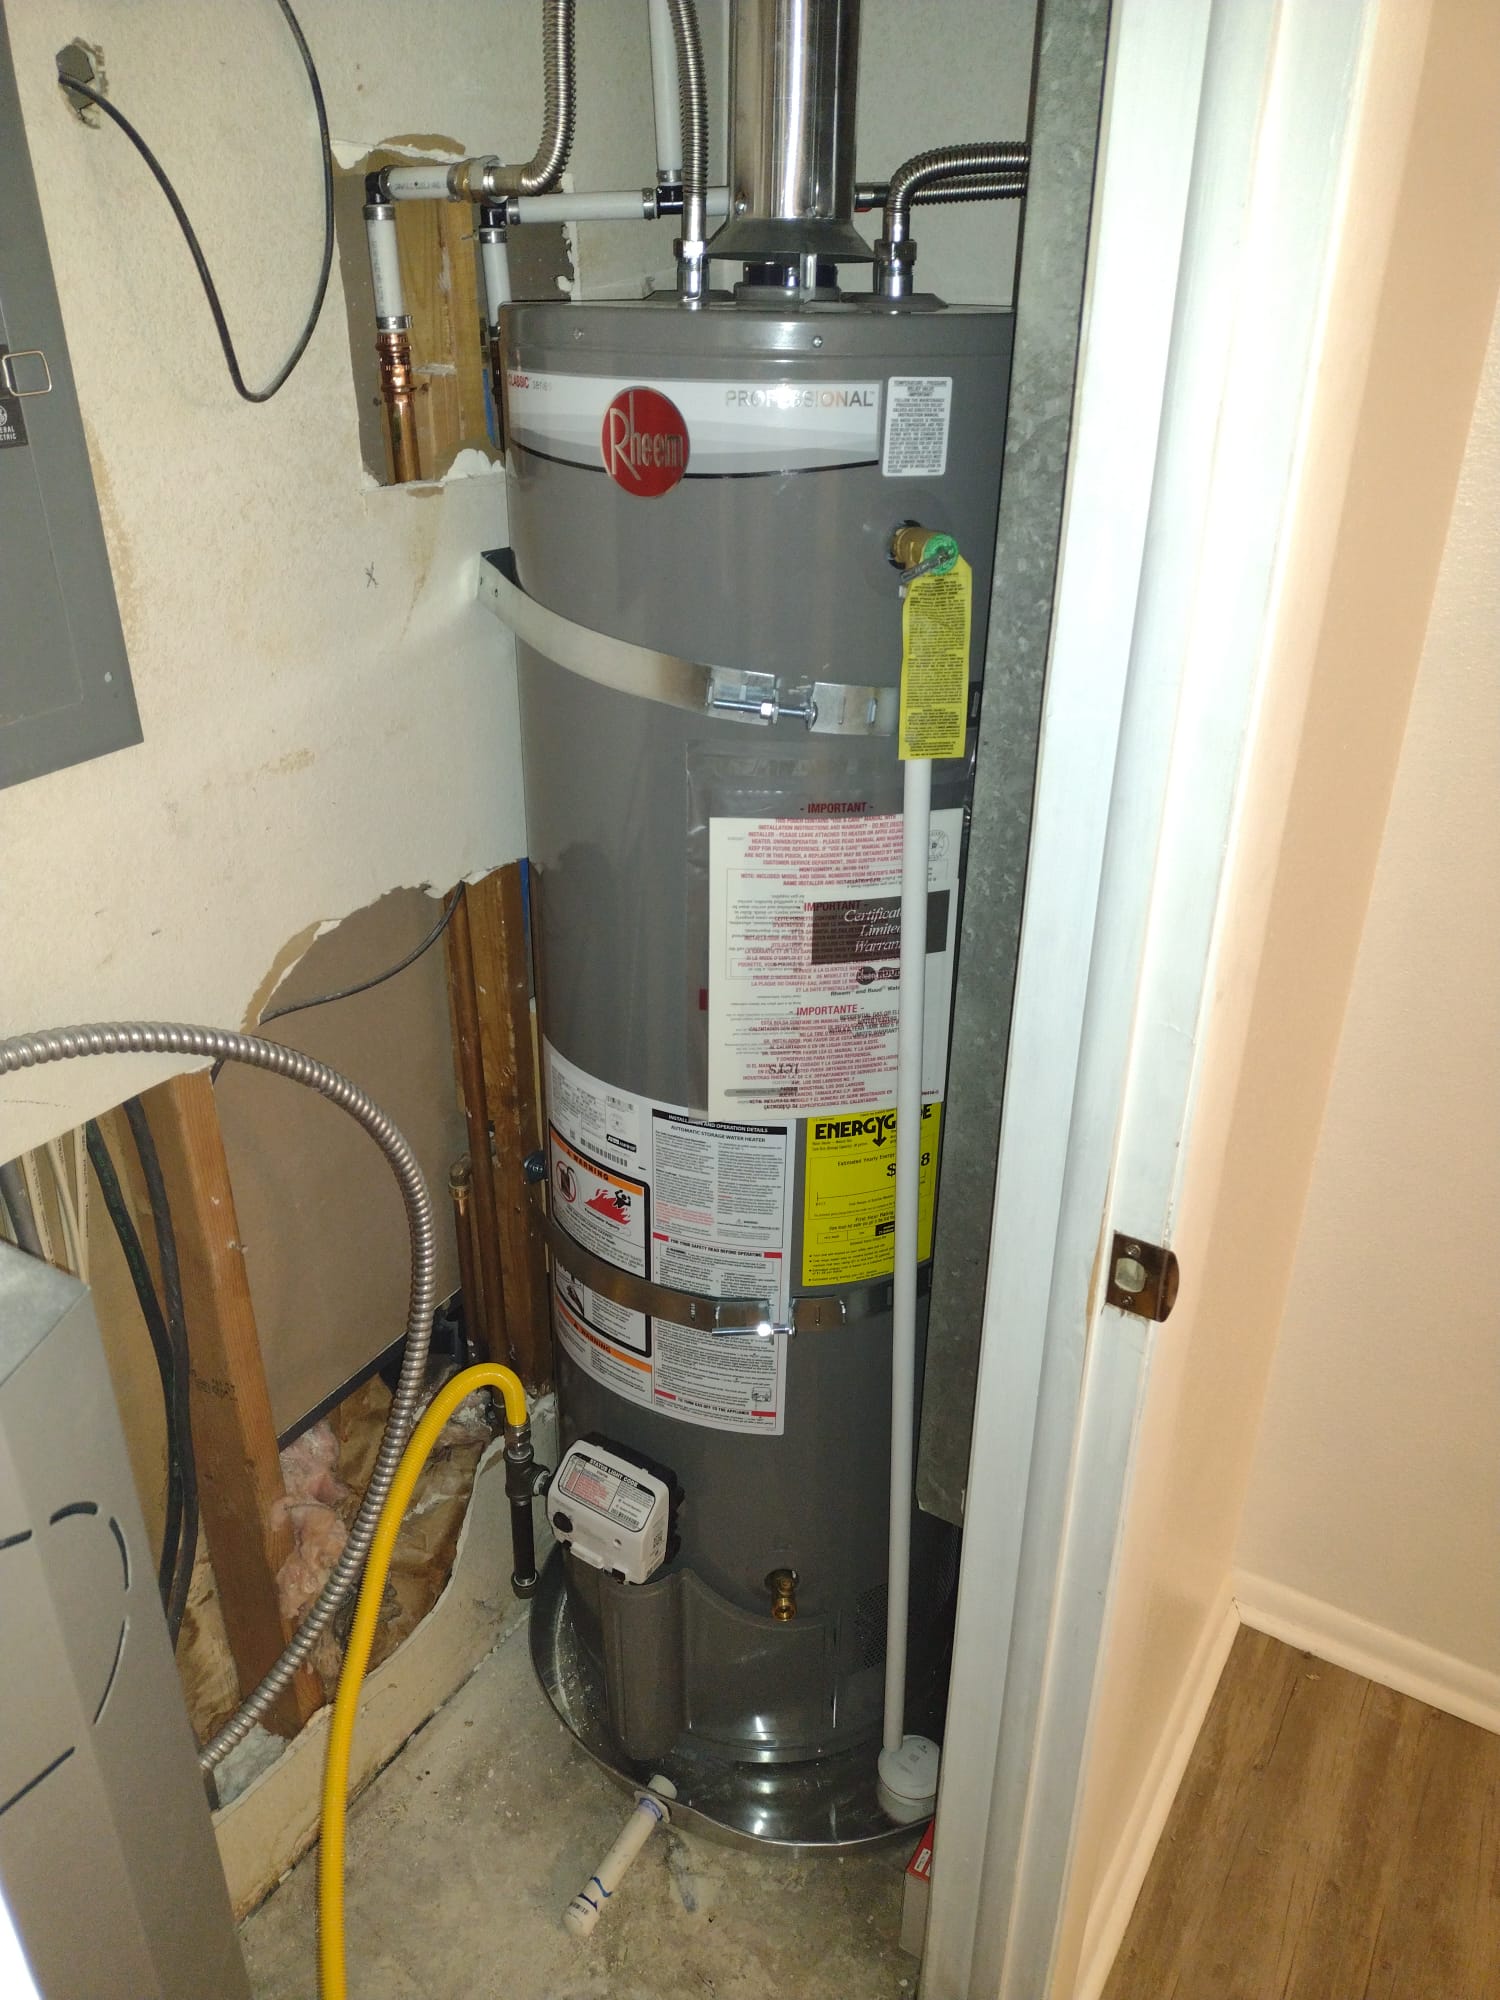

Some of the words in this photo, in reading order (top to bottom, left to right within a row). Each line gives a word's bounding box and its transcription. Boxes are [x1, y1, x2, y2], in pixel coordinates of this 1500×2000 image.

[610, 391, 684, 481] Rheem
[807, 802, 867, 814] IMPORTANT
[804, 901, 860, 912] IMPORTANT
[844, 907, 901, 922] Certificat
[797, 1005, 858, 1016] IMPORTANTE
[671, 1125, 701, 1136] AUTOMATIC
[701, 1131, 725, 1139] STORAGE
[716, 1123, 746, 1132] OPERATION
[575, 1157, 609, 1181] WARNING
[691, 1243, 707, 1251] SAFETY
[580, 1329, 612, 1354] WARNING
[589, 1459, 609, 1472] STATUS
[608, 1468, 623, 1480] LIGHT
[623, 1476, 639, 1488] CODE
